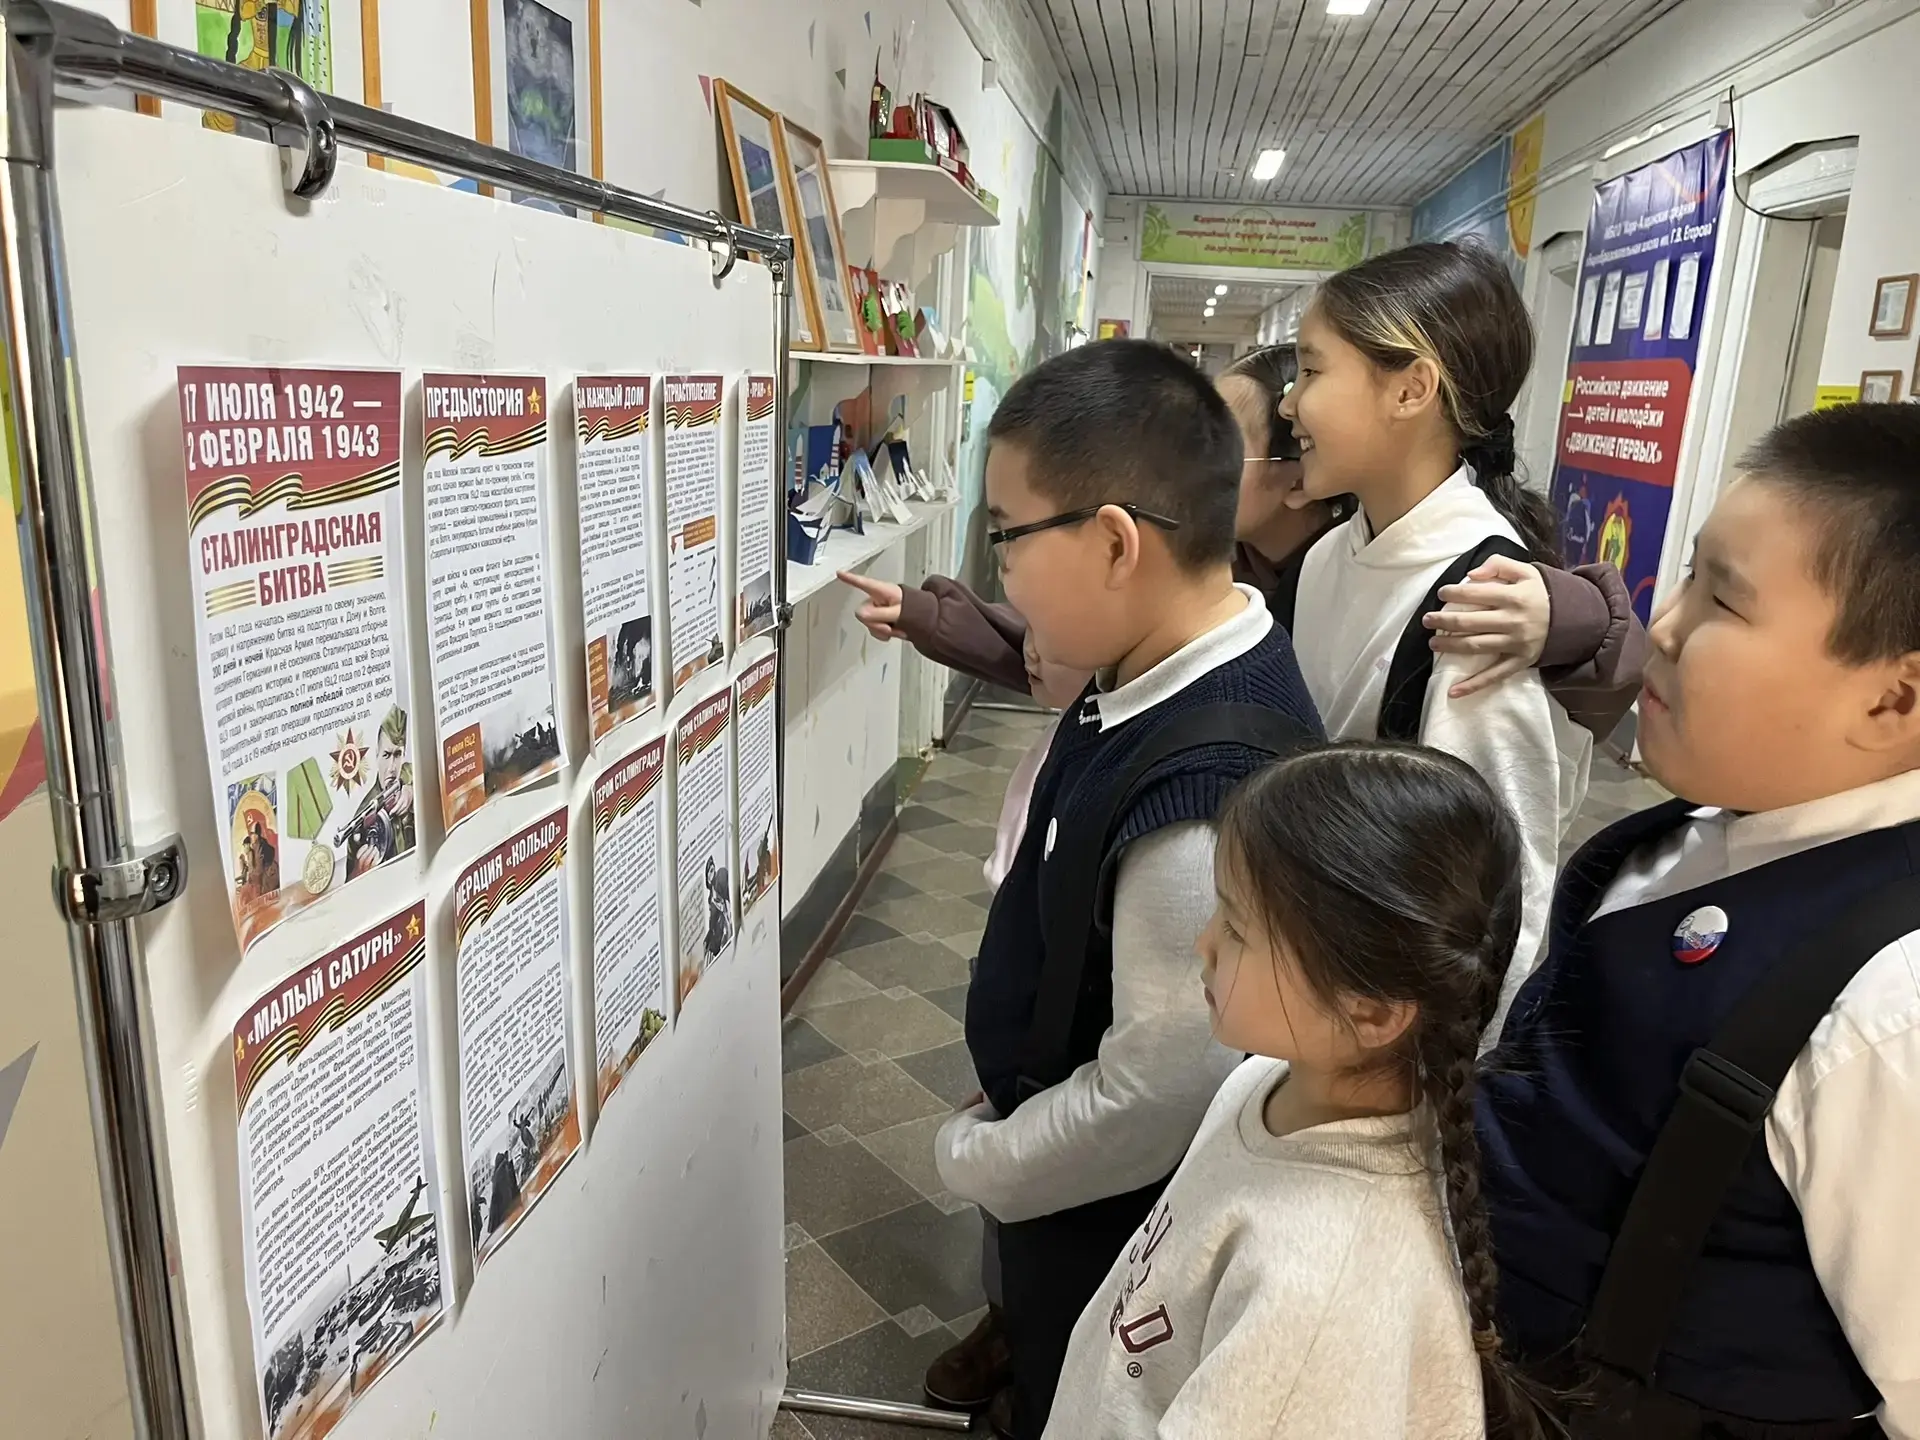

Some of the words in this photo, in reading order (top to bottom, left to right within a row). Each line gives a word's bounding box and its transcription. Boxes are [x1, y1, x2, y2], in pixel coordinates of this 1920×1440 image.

[184, 383, 197, 423] 17
[205, 382, 277, 422] ИЮЛЯ
[284, 383, 344, 419] 1942
[586, 384, 623, 411] КАЖДЫЙ
[624, 386, 644, 410] ДОМ
[1576, 375, 1621, 396] Российское
[1620, 380, 1669, 400] движение
[426, 386, 524, 423] ПРЕДЫСТОРИЯ
[1585, 403, 1611, 424] детей
[187, 431, 197, 472] 2
[200, 425, 314, 469] ФЕВРАЛЯ
[321, 424, 380, 460] 1943
[1615, 437, 1663, 464] ПЕРВЫХ»
[201, 511, 382, 575] СТАЛИНГРАДСКАЯ
[258, 561, 327, 606] БИТВА
[254, 615, 284, 628] началась
[324, 603, 332, 612] по
[333, 598, 354, 610] своему
[276, 627, 295, 639] битва
[296, 624, 305, 634] на
[345, 611, 361, 623] Дону
[238, 658, 242, 666] и
[244, 649, 263, 664] ночей
[265, 643, 292, 659] Красная
[294, 638, 313, 651] Армия
[322, 637, 370, 657] Сталинградская
[265, 675, 293, 690] историю
[301, 661, 339, 678] переломила
[306, 680, 323, 692] июля
[323, 673, 337, 686] 1942
[338, 671, 352, 682] года
[289, 696, 313, 712] полной
[315, 686, 343, 703] победой
[345, 680, 373, 695] советских
[596, 777, 614, 808] ГЕРОИ
[614, 746, 660, 791] СТАЛИНГРАДА
[456, 853, 503, 917] ПЕРАЦИЯ
[505, 821, 561, 868] «КОЛЬЦО»
[247, 966, 325, 1045] «МАЛЫЙ
[328, 927, 403, 990] САТУРН»
